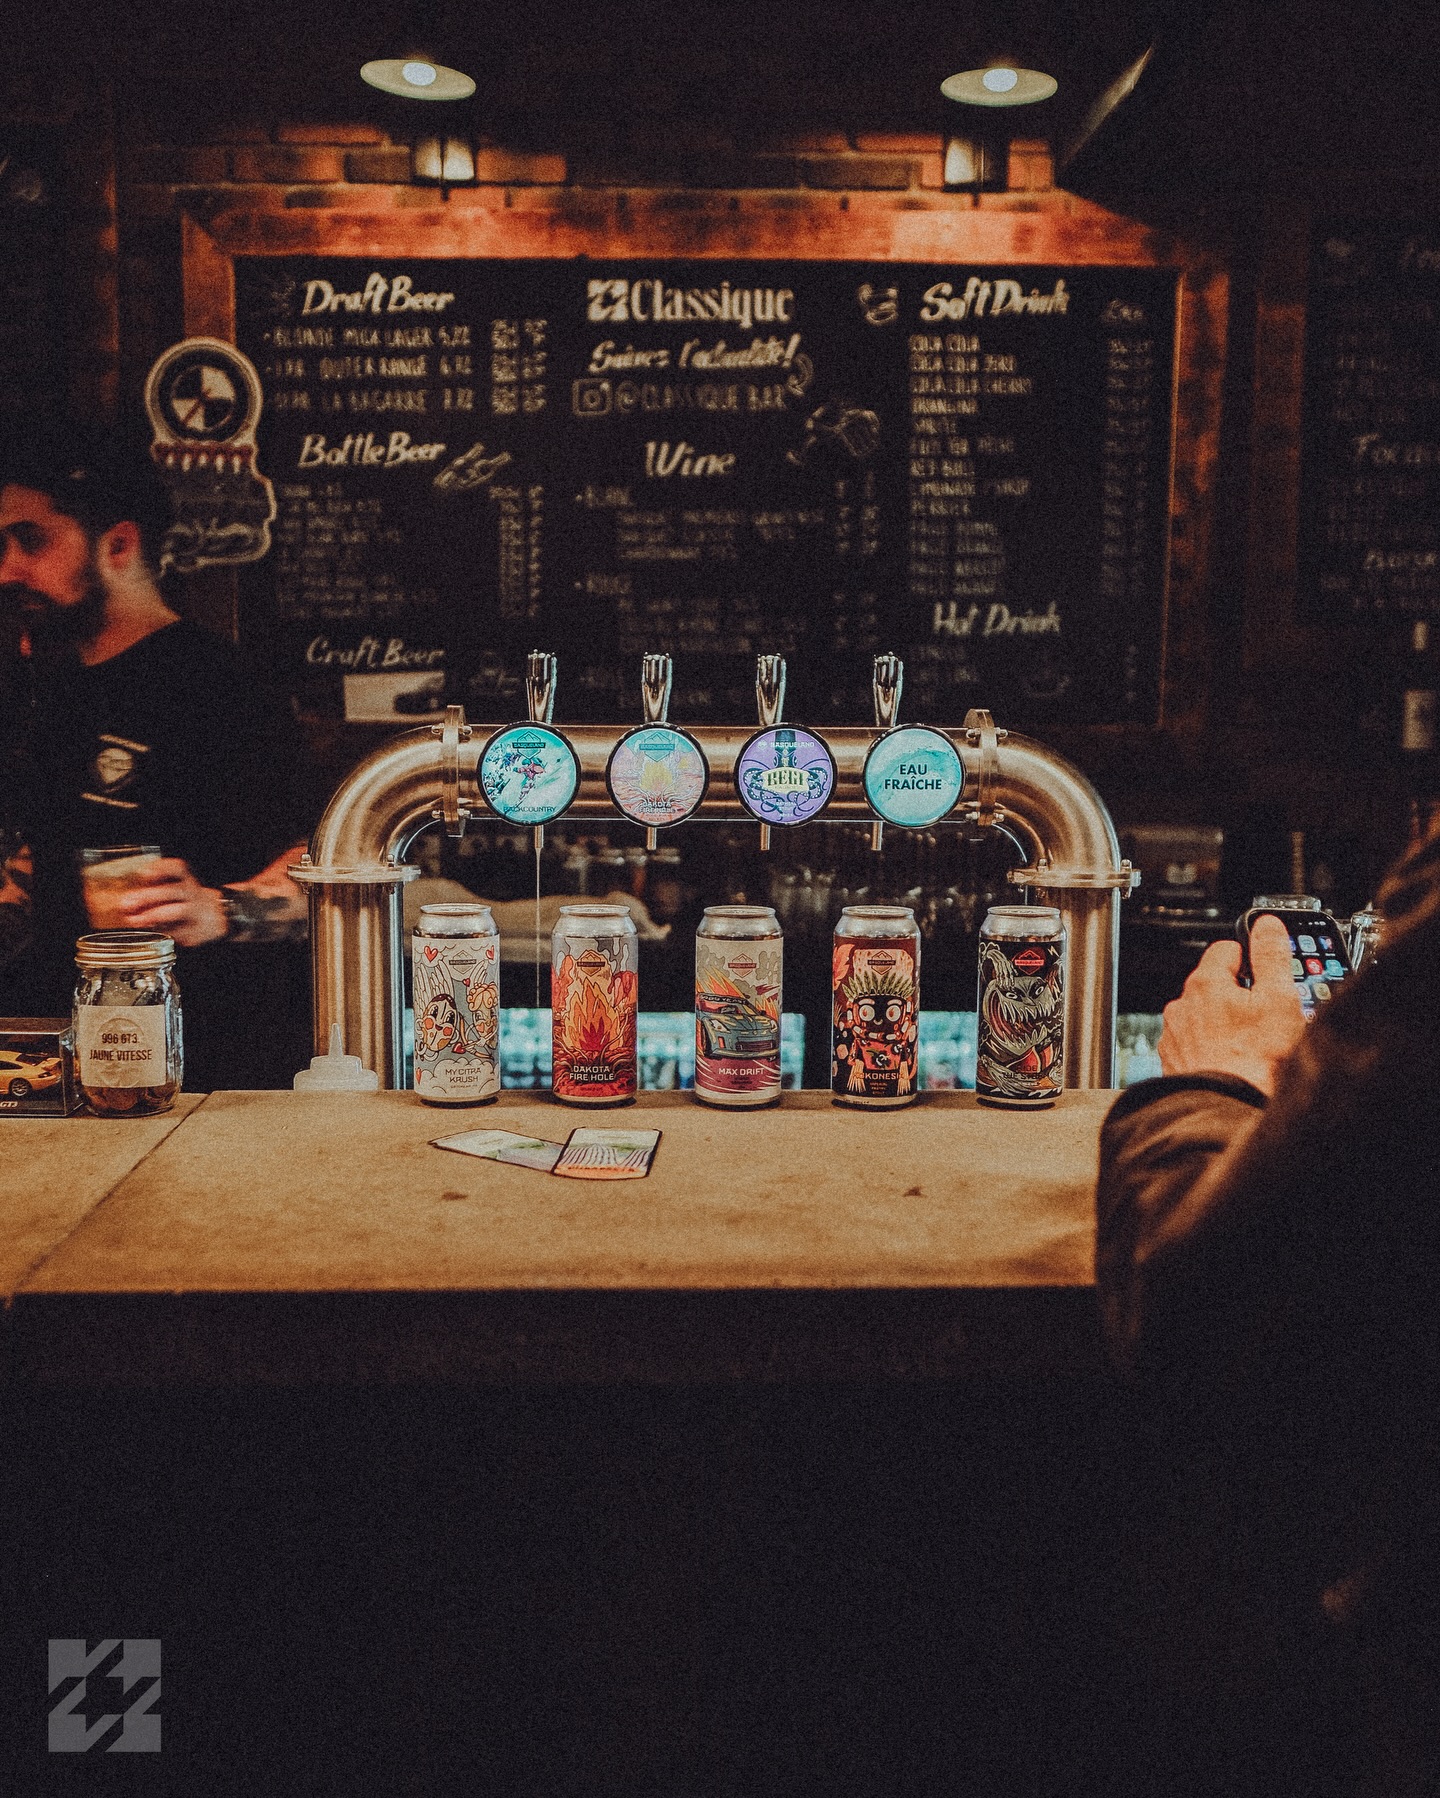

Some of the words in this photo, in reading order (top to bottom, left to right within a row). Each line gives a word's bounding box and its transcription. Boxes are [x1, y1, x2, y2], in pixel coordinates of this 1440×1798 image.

[302, 272, 389, 314] Draft
[386, 275, 455, 313] Beer
[920, 277, 991, 322] Soft
[989, 279, 1070, 315] Drink
[631, 279, 794, 329] Classique
[298, 433, 384, 468] Bottle
[384, 431, 446, 468] Beer
[645, 440, 736, 477] Wine
[932, 601, 978, 636] Hot
[306, 634, 379, 668] Craft
[381, 638, 445, 667] Beer
[899, 764, 927, 775] EAU
[884, 775, 942, 790] FRAÎCHE
[101, 1033, 119, 1044] 996
[90, 1050, 113, 1060] JAUNE
[116, 1049, 152, 1061] VITESSE
[458, 1067, 481, 1075] CITRA
[569, 1073, 588, 1081] FIRE
[590, 1073, 614, 1081] HOLE
[573, 1065, 610, 1074] DAKOTA
[739, 1068, 764, 1076] DRIFT
